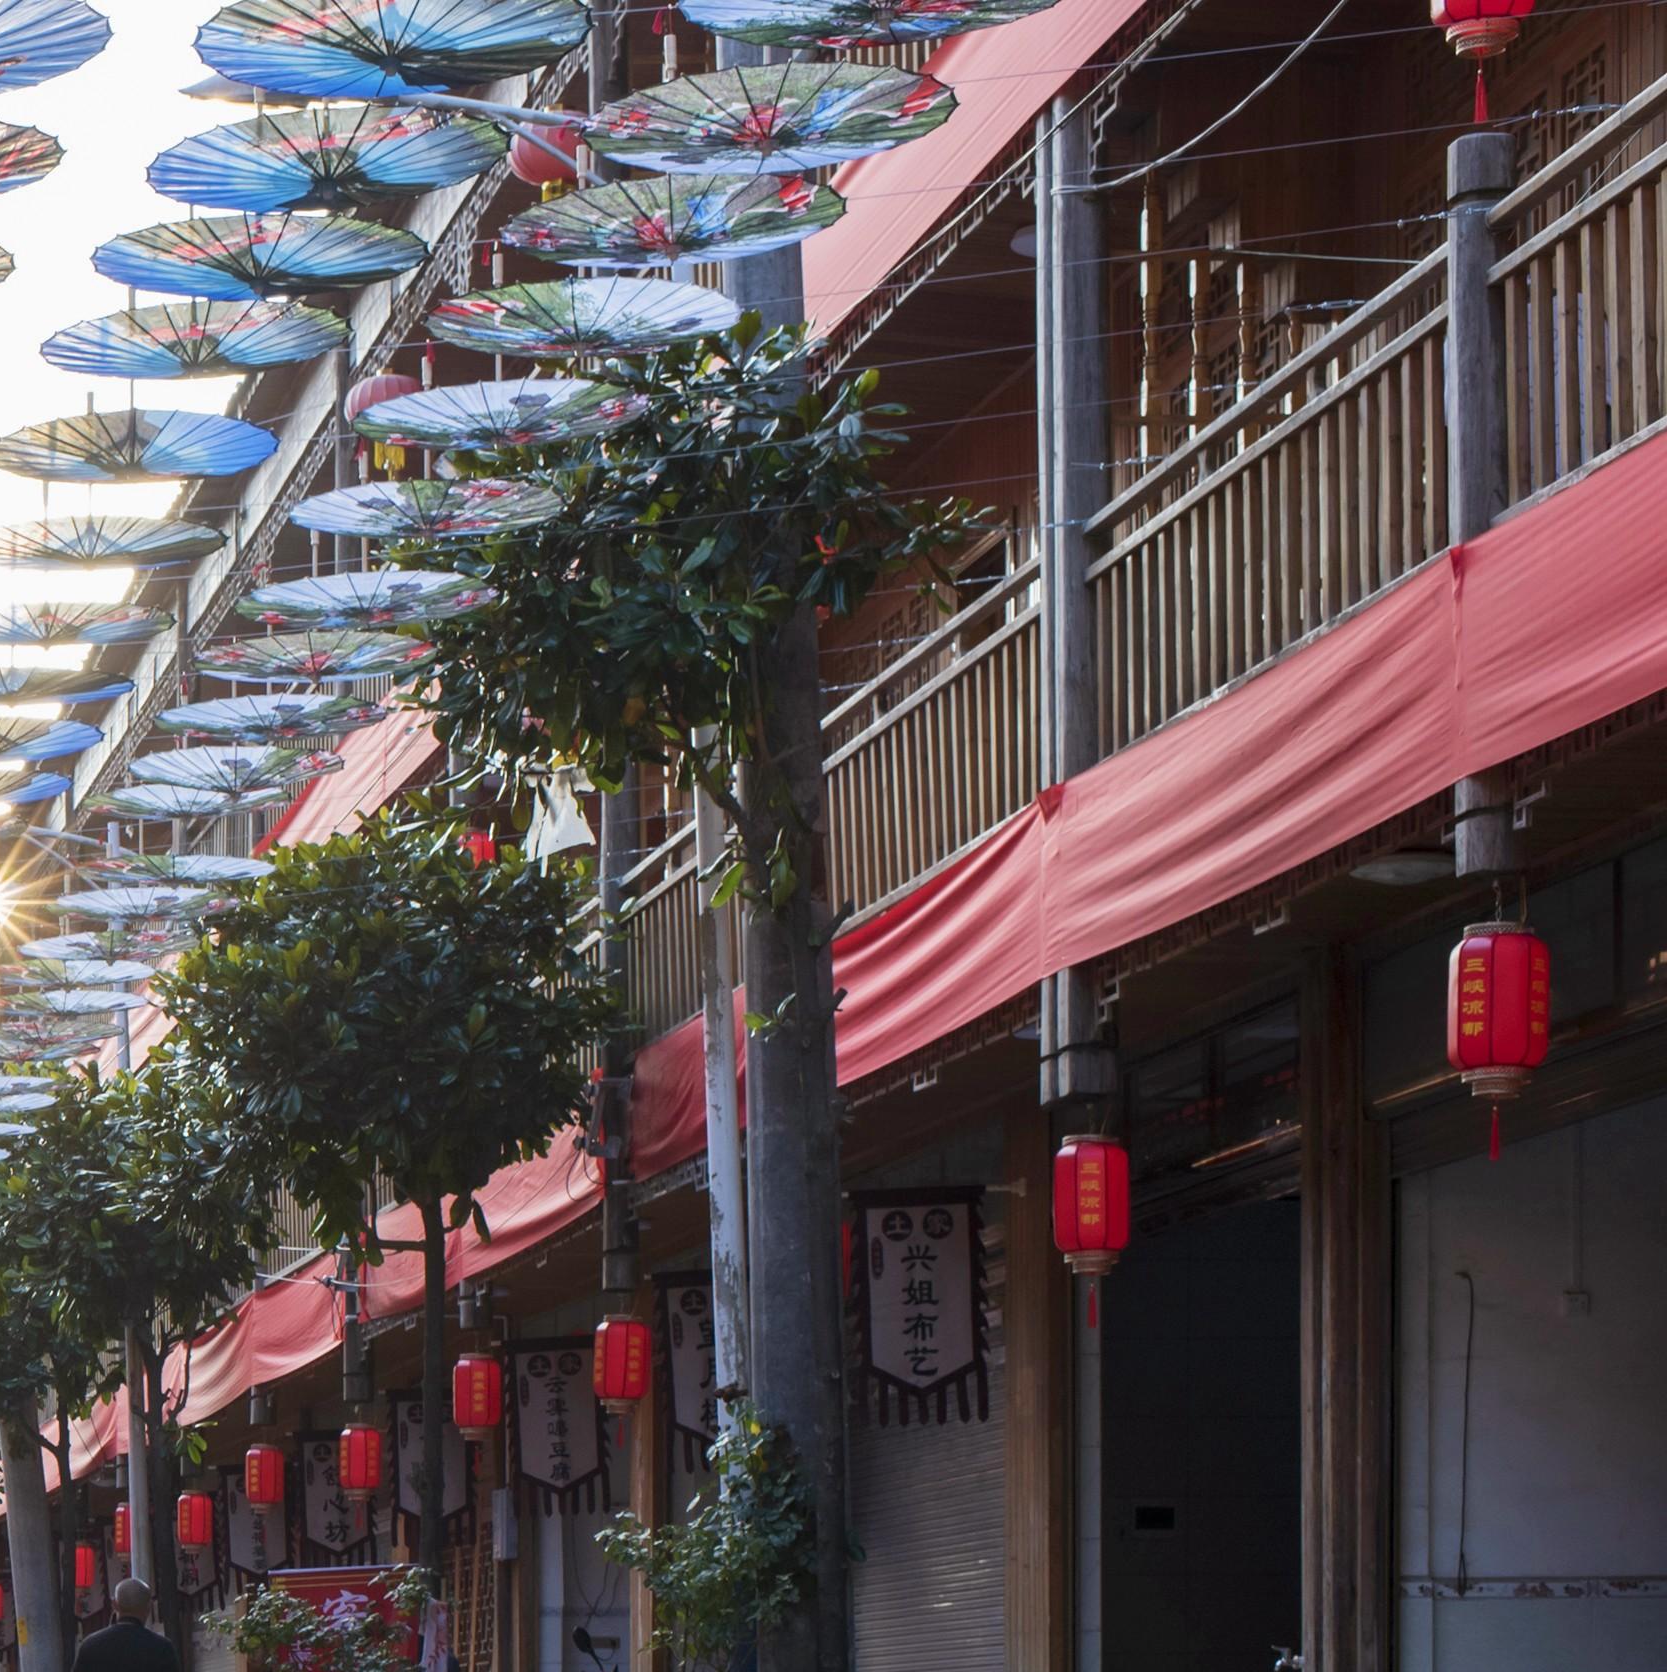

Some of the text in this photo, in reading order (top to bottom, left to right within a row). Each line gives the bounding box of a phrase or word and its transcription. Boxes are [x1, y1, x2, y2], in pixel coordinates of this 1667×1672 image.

[1462, 958, 1486, 1037] 三峡凉都
[886, 1214, 951, 1236] 土家
[900, 1245, 939, 1377] 兴姐布艺
